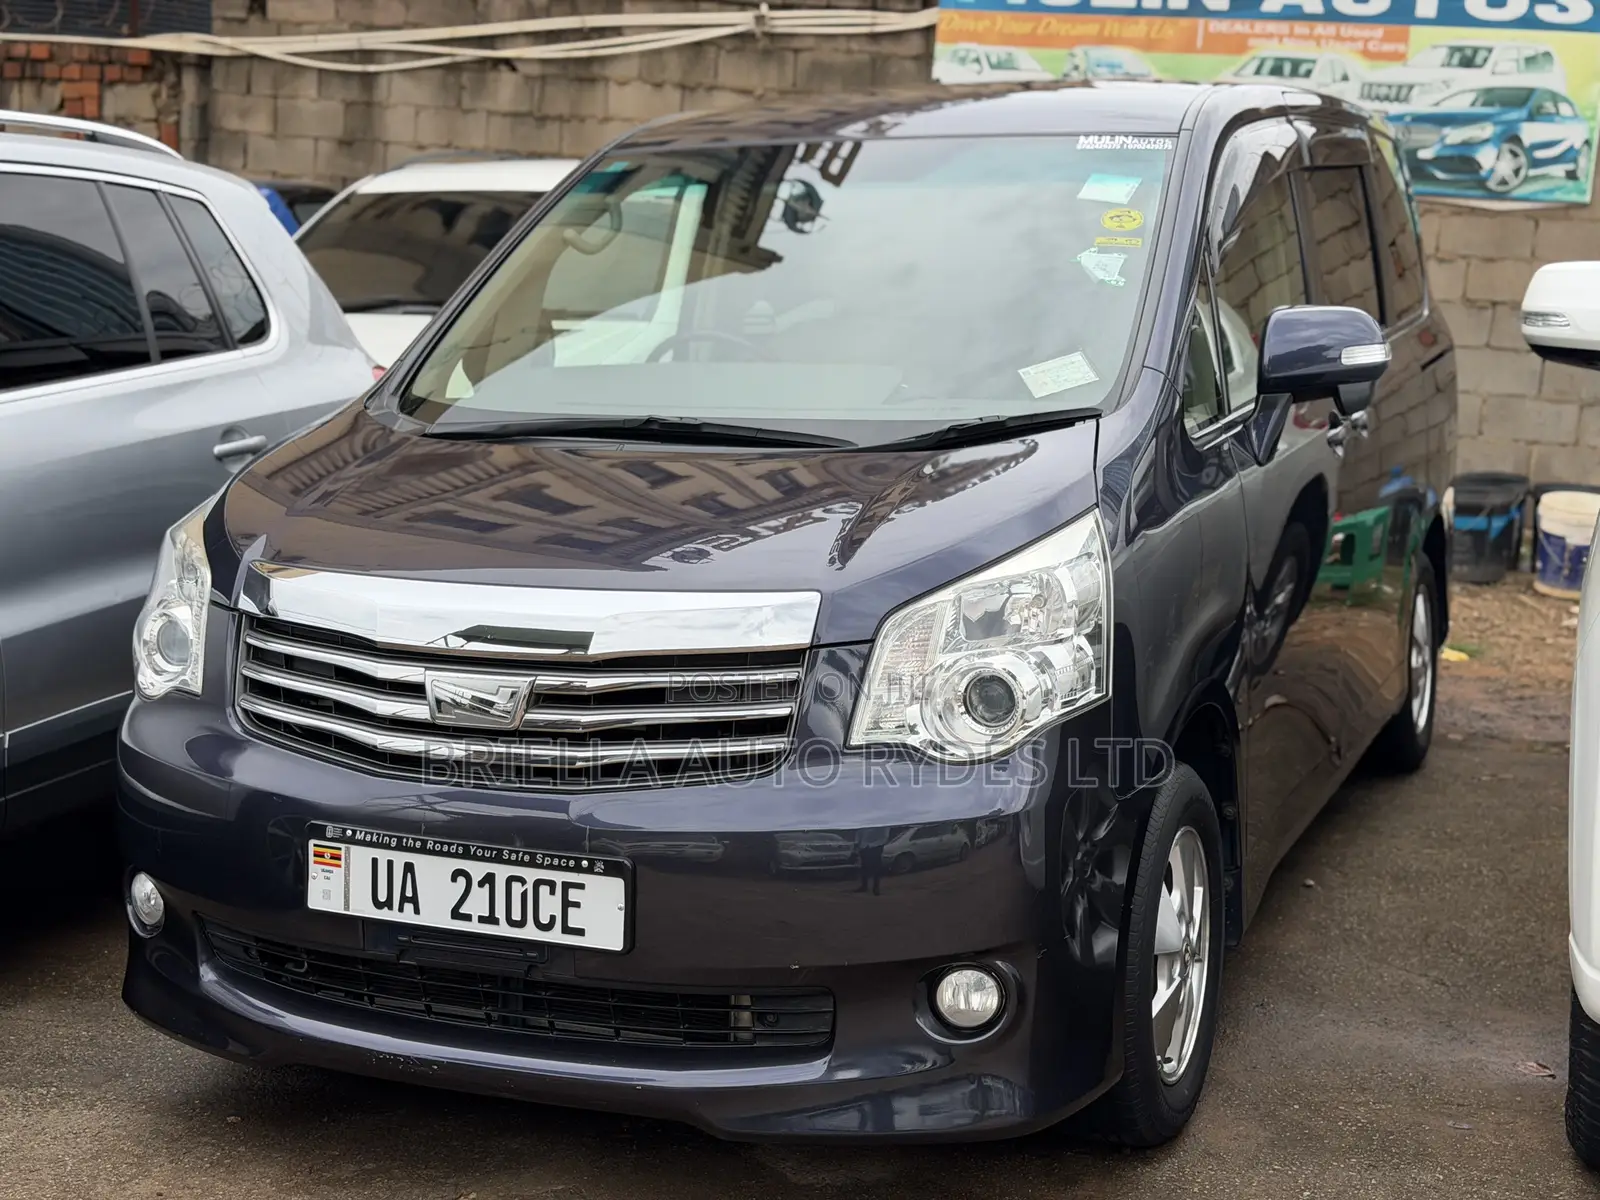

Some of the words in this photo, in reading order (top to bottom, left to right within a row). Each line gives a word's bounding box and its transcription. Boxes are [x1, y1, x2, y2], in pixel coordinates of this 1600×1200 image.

[355, 830, 398, 848] Making
[402, 838, 422, 849] the
[426, 840, 464, 854] Roads
[469, 845, 498, 858] Your
[502, 849, 531, 863] Safe
[535, 854, 576, 867] Space
[370, 856, 421, 916] UA
[450, 867, 587, 937] 210CE
